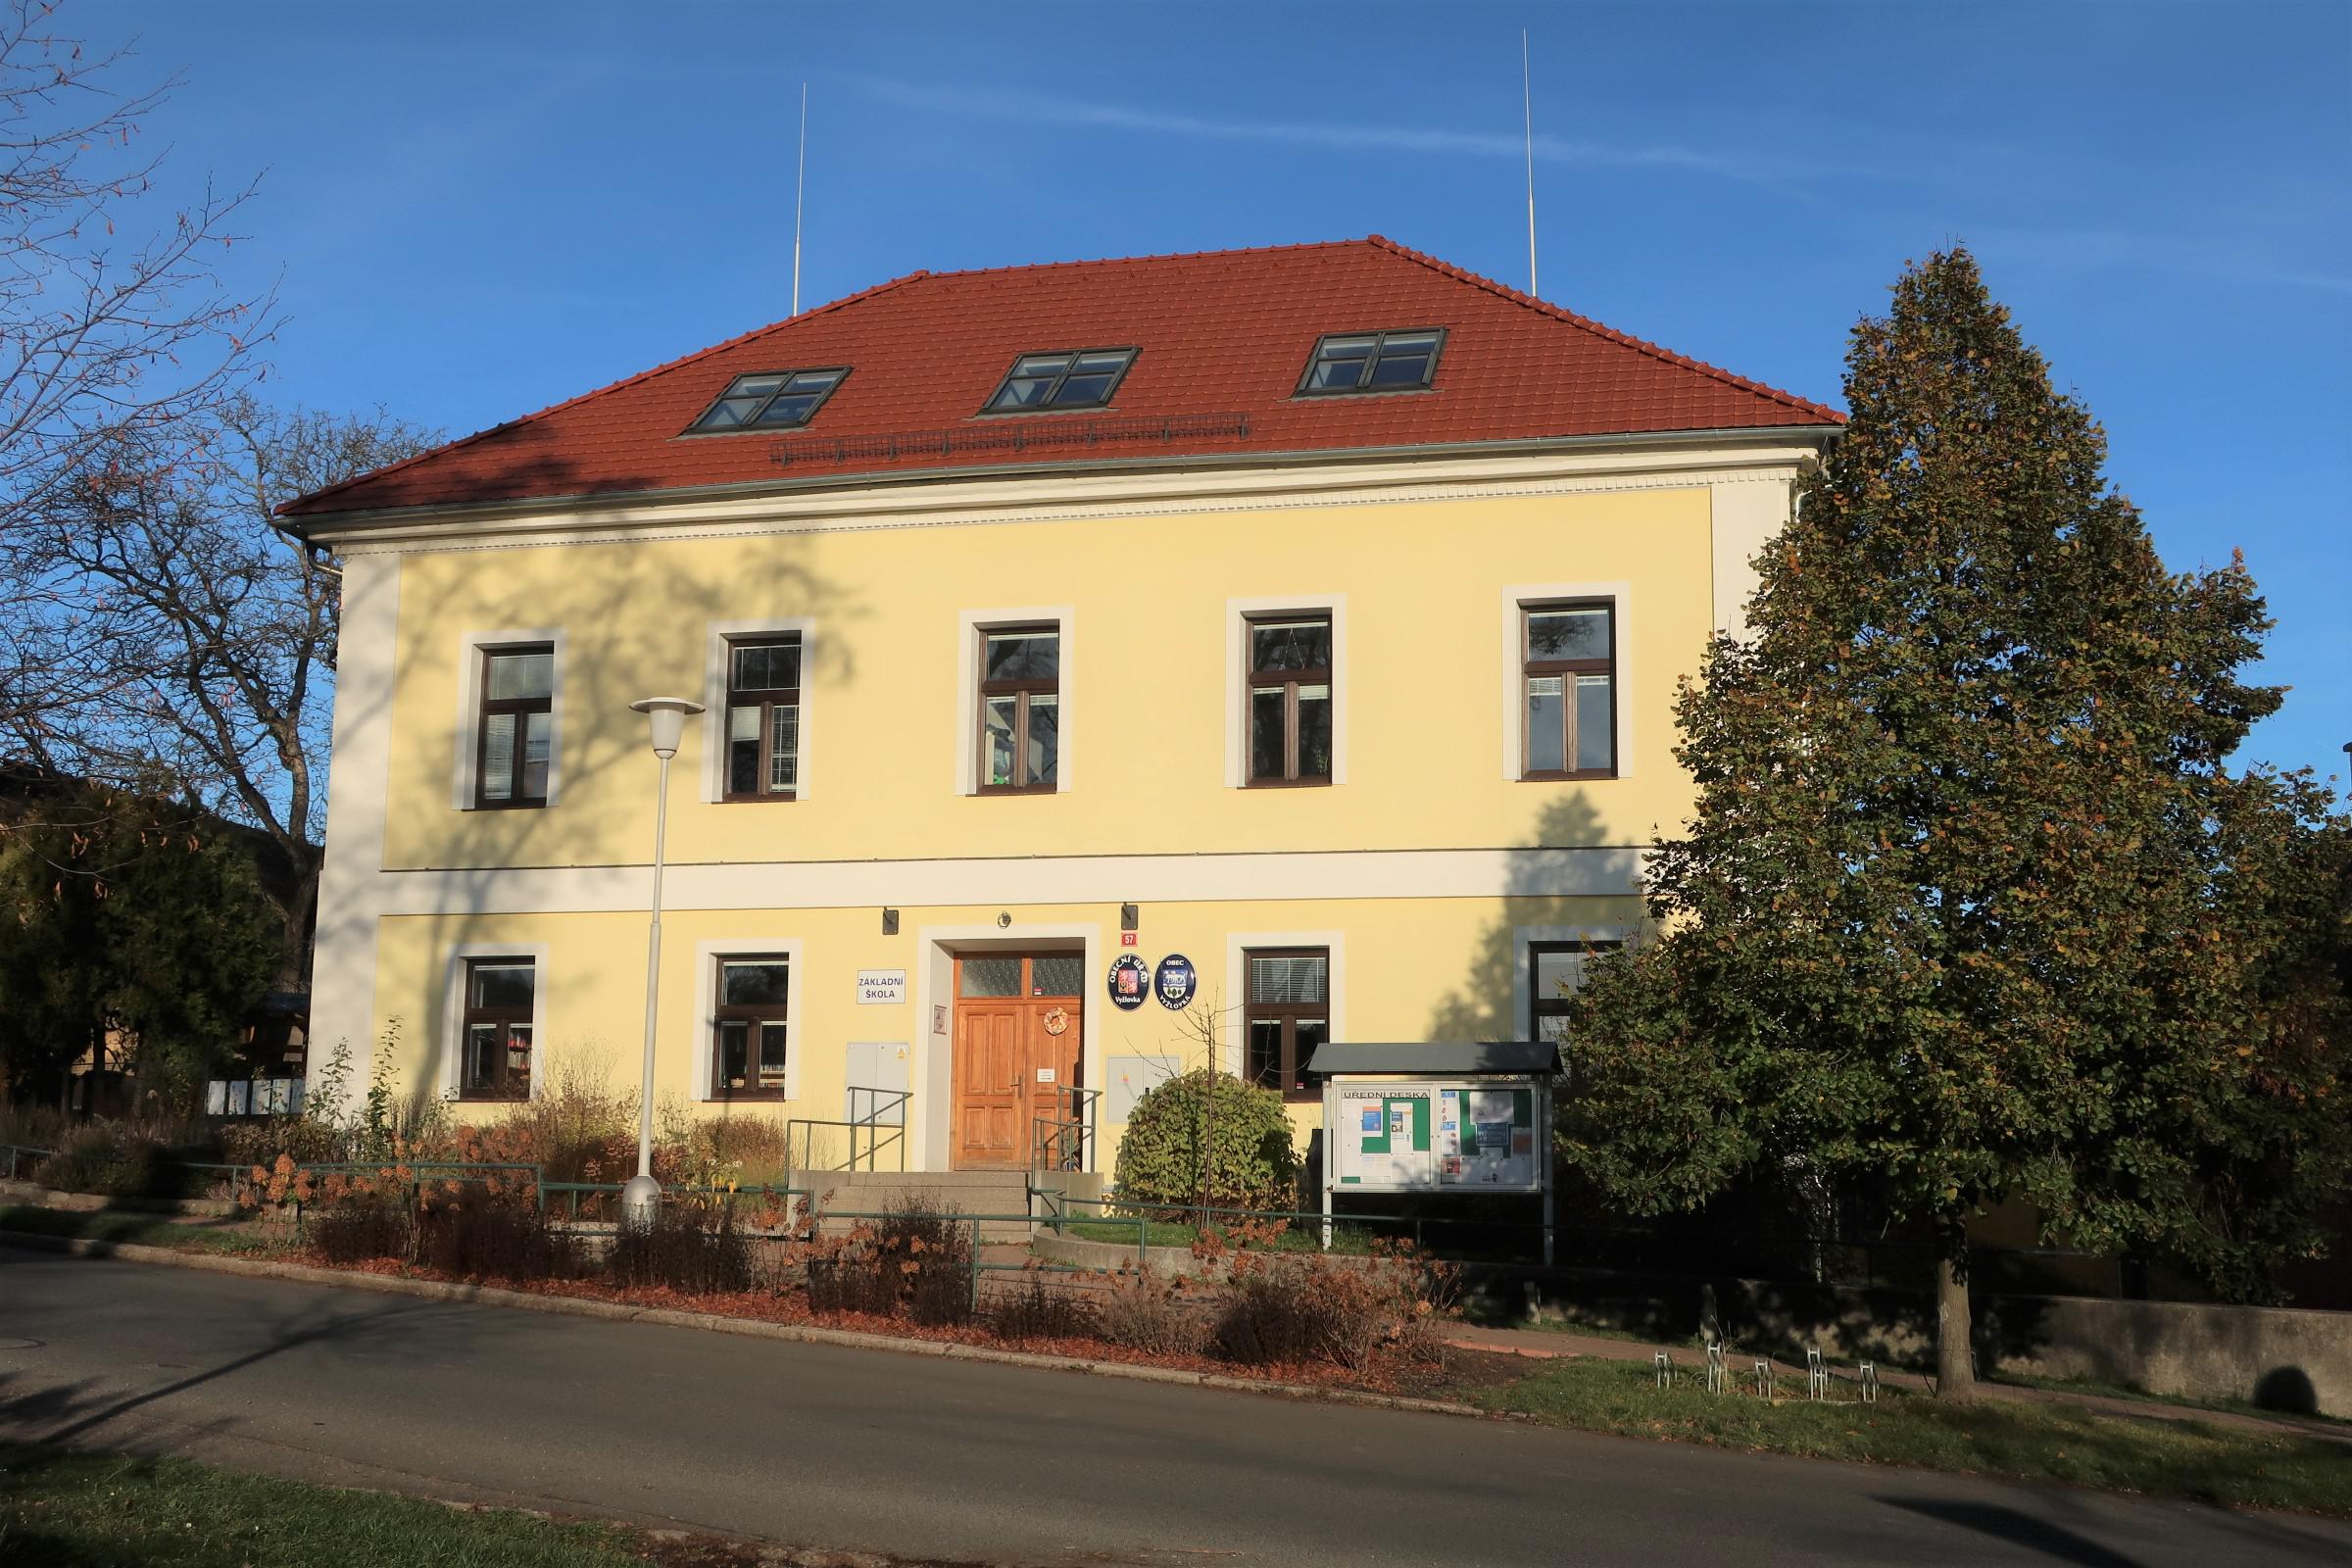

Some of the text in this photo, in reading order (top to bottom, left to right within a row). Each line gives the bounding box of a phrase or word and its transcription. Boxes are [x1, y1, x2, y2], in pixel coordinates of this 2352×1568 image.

[1124, 935, 1134, 945] 57
[1109, 955, 1132, 983] OBECNÍ
[858, 976, 904, 986] ZÁKLADNÍ
[865, 989, 895, 999] ŠKOLA
[1115, 996, 1141, 1004] Vyžlovka
[1344, 1090, 1386, 1099] ÚŘEDNÍ
